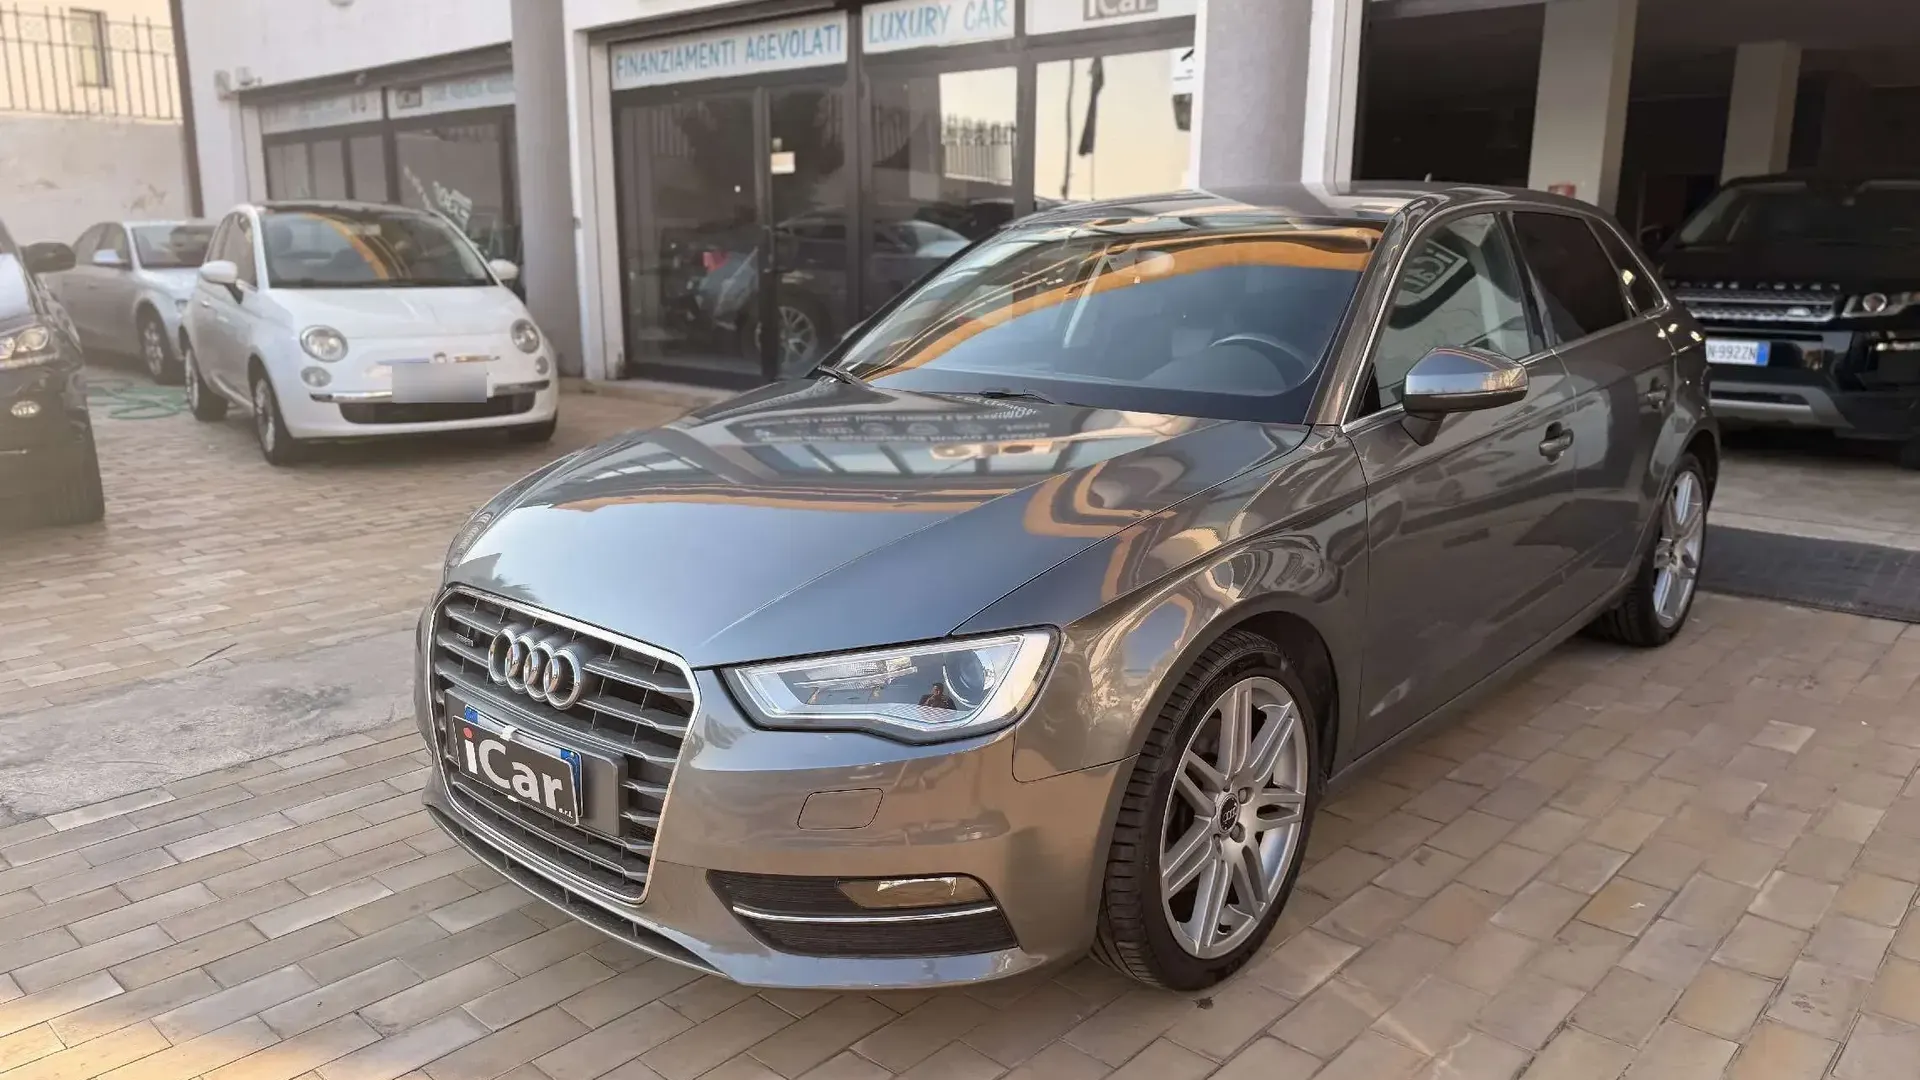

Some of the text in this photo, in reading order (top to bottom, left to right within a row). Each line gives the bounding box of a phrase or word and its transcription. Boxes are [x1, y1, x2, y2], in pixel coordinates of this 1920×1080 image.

[868, 0, 1008, 45] LUXURY CAR
[616, 24, 842, 80] FINANZIAMENTI AGEVOLATI
[463, 727, 564, 811] iCar
